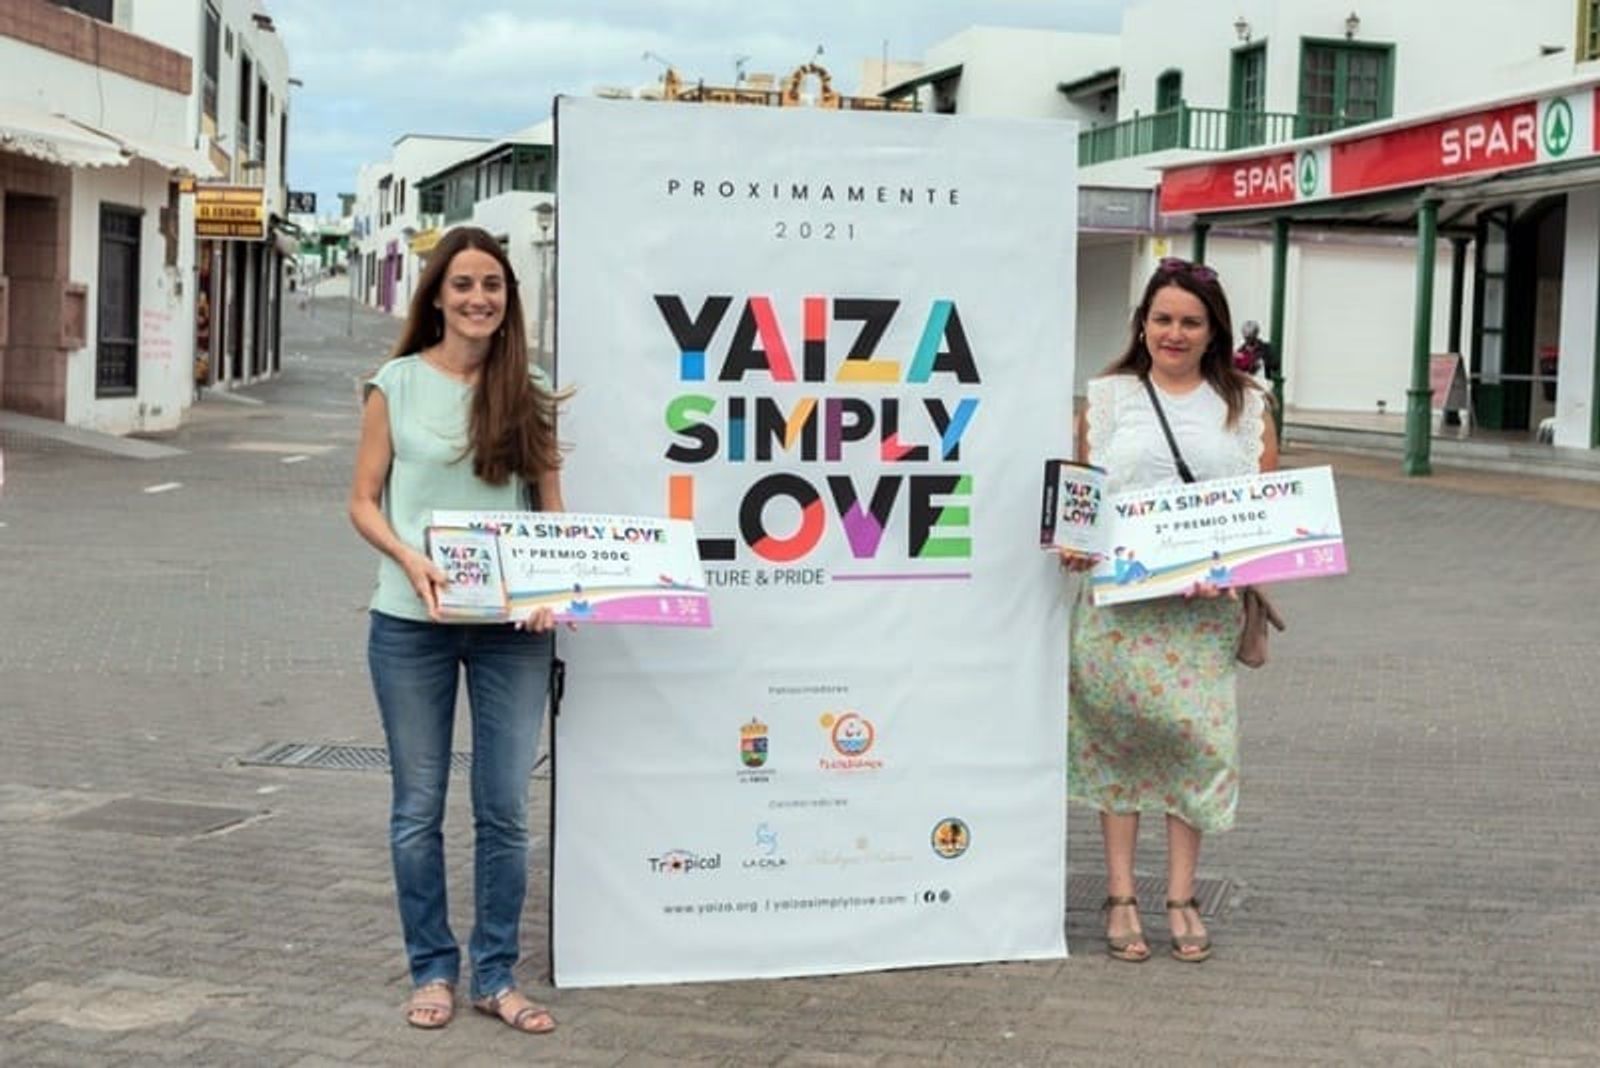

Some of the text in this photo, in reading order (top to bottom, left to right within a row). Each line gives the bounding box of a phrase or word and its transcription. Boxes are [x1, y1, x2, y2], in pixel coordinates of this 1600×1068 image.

[1441, 115, 1536, 165] SPAR
[668, 180, 961, 205] PROXIMAMENTE
[1233, 163, 1294, 198] SPAR
[775, 221, 855, 241] 2021
[653, 294, 981, 384] YAIZA
[664, 394, 981, 464] SIMPLY
[1115, 500, 1172, 519] YAIZA
[1175, 488, 1244, 511] SIMPLY
[1250, 480, 1304, 501] LOVE
[668, 472, 973, 563] LOVE
[1173, 515, 1228, 531] PREMIO
[535, 523, 606, 540] SIMPLY
[612, 527, 668, 543] LOVE
[530, 549, 587, 560] PREMIO
[704, 569, 825, 586] TURE & PRIDE
[647, 854, 721, 873] Tropical
